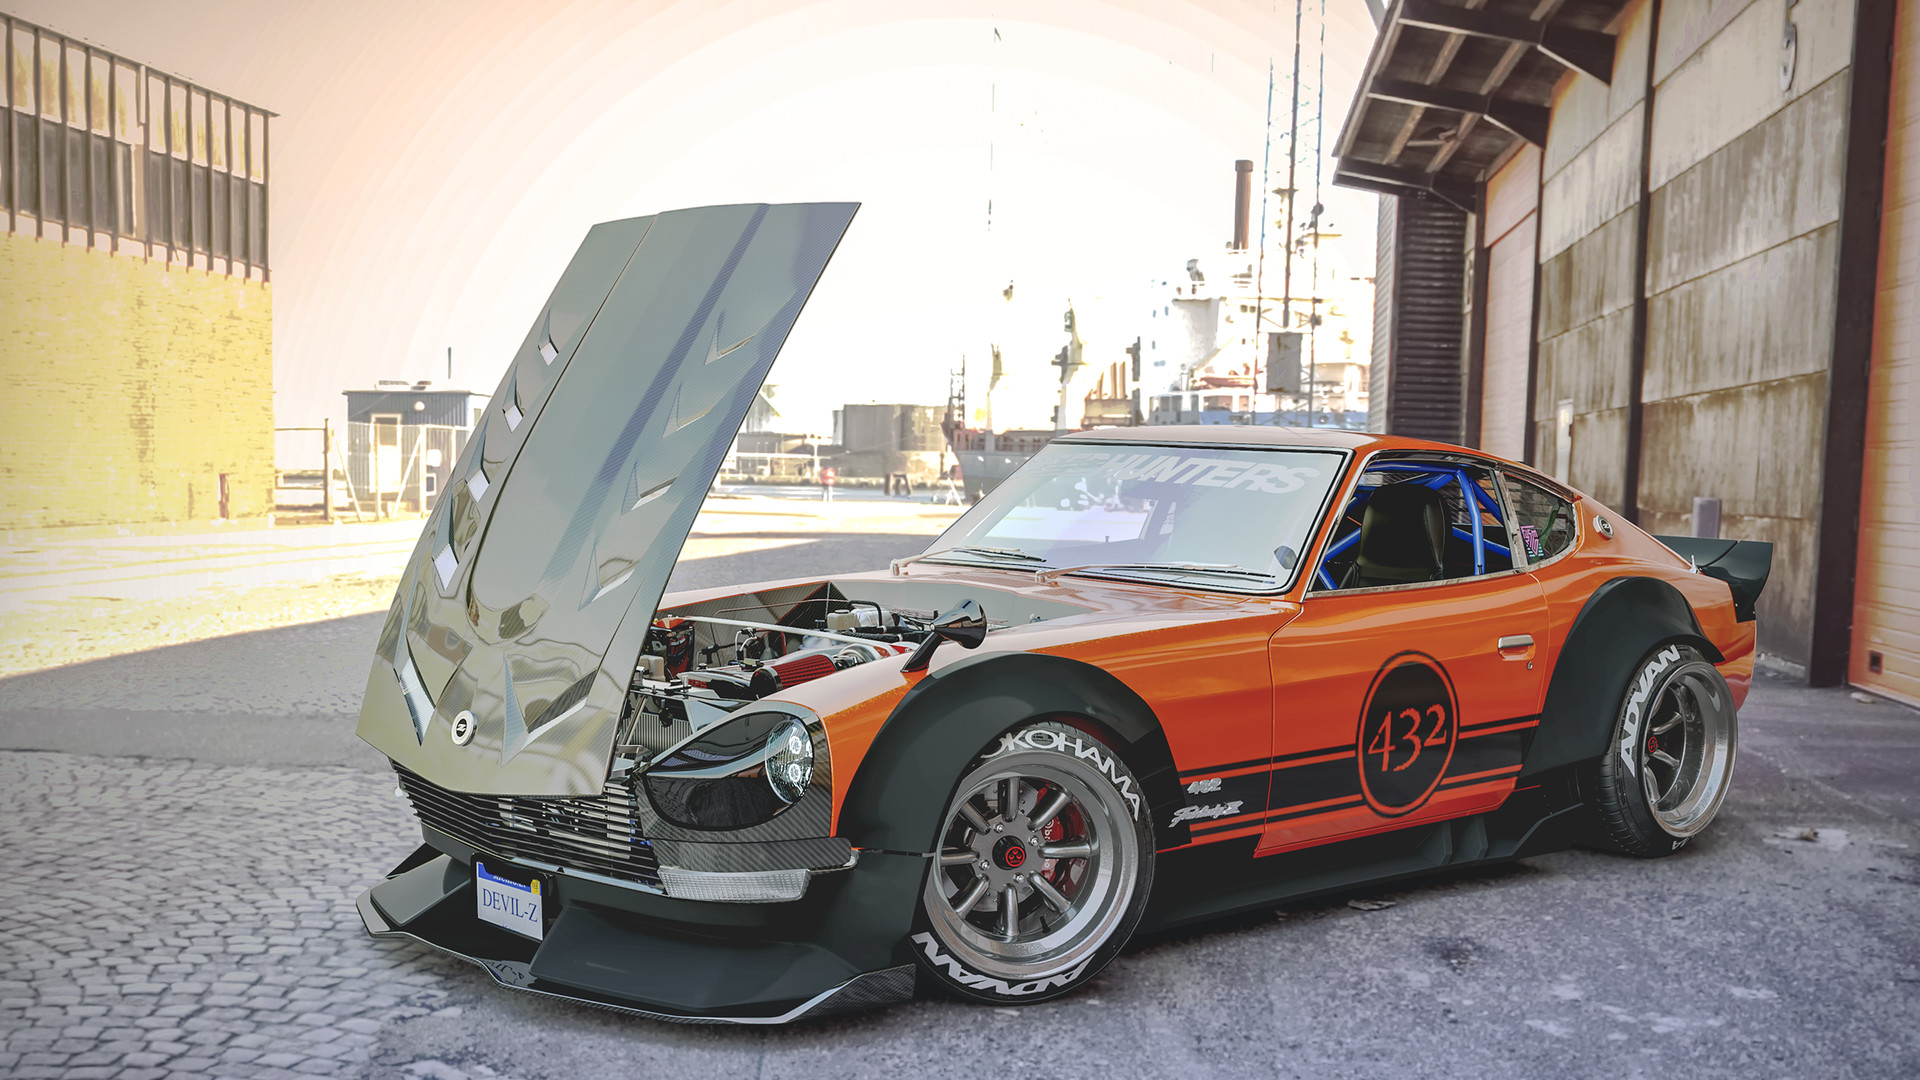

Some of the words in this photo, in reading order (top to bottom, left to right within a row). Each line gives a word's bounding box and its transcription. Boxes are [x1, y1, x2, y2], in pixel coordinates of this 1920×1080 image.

[1368, 704, 1447, 772] 432
[1621, 644, 1681, 777] ADVAN
[980, 730, 1140, 821] KOHAMA
[482, 888, 538, 923] DEVIL-Z
[911, 932, 1097, 996] ADVAN
